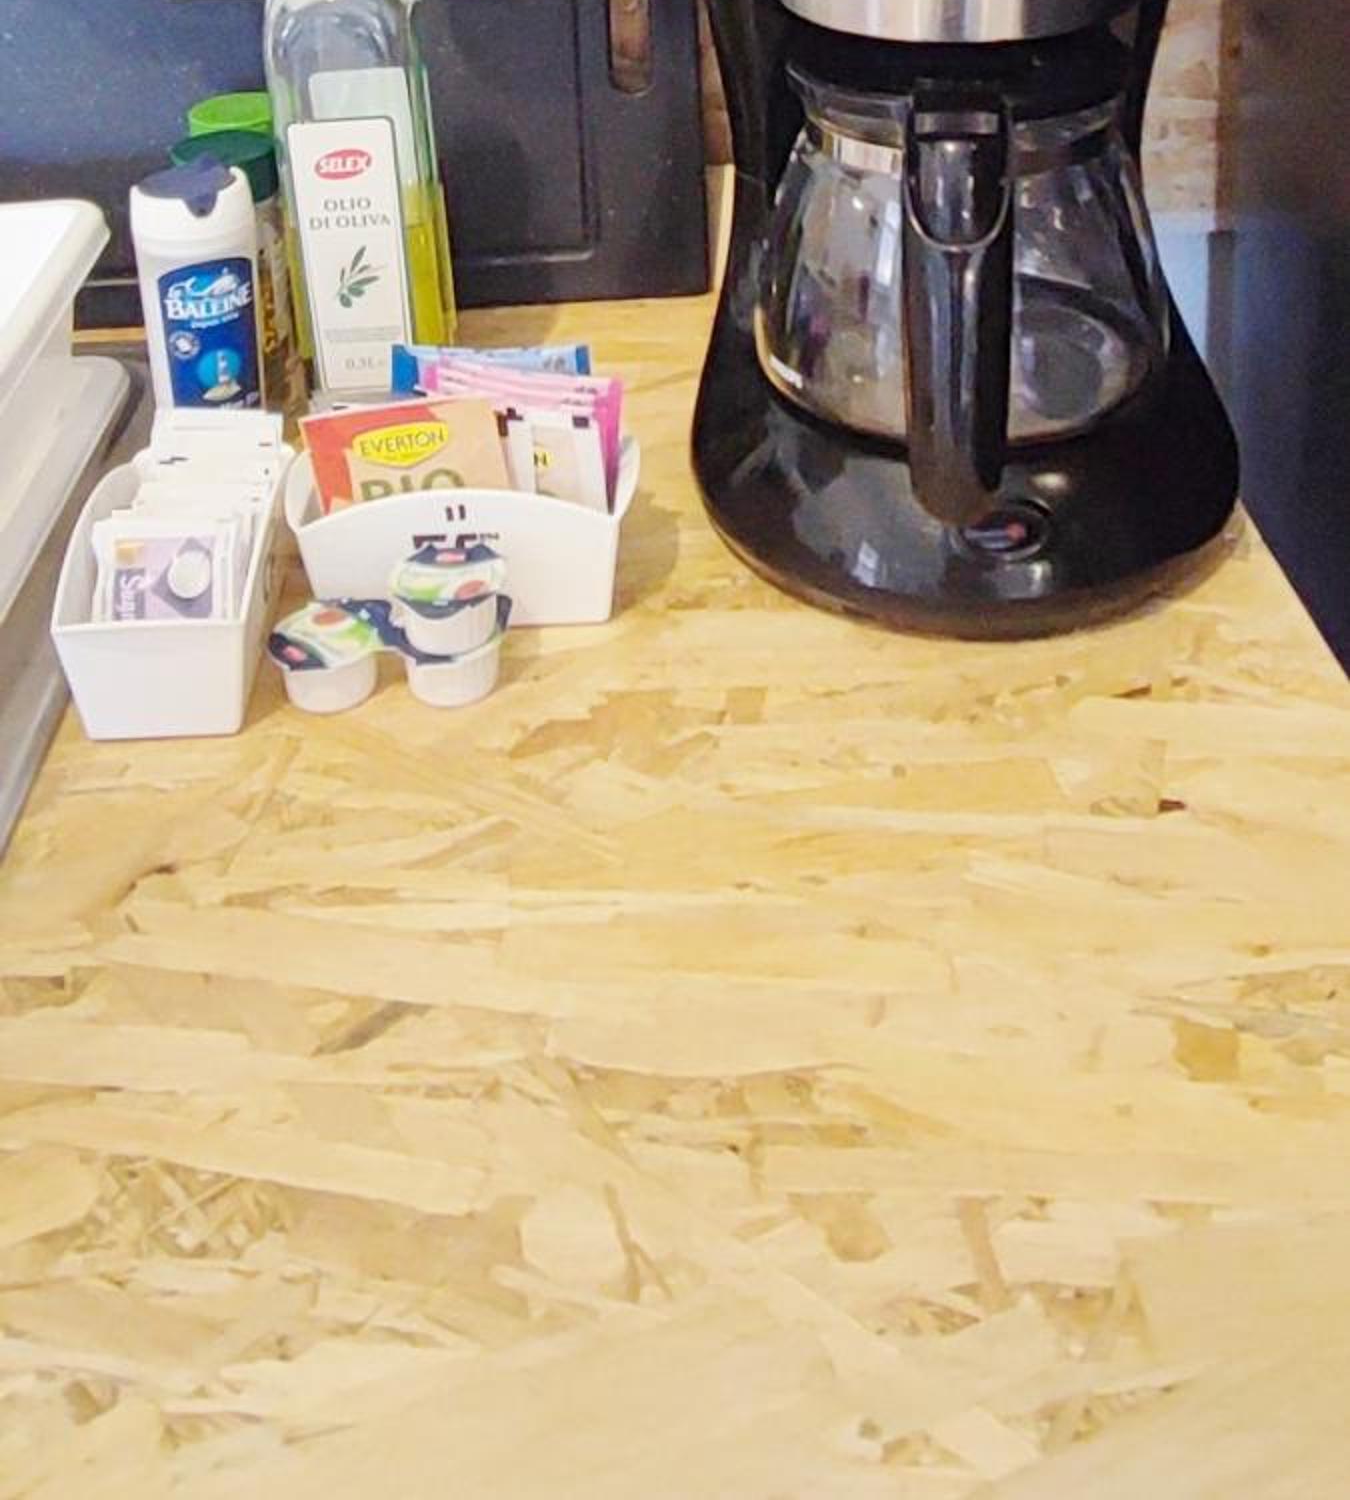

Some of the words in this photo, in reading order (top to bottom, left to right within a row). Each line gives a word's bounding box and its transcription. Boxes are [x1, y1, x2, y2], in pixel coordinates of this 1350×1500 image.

[317, 153, 371, 176] SELEX
[323, 197, 372, 212] OLIO
[309, 216, 330, 230] DI
[335, 213, 391, 229] OLIVA
[359, 427, 445, 456] EVERTON
